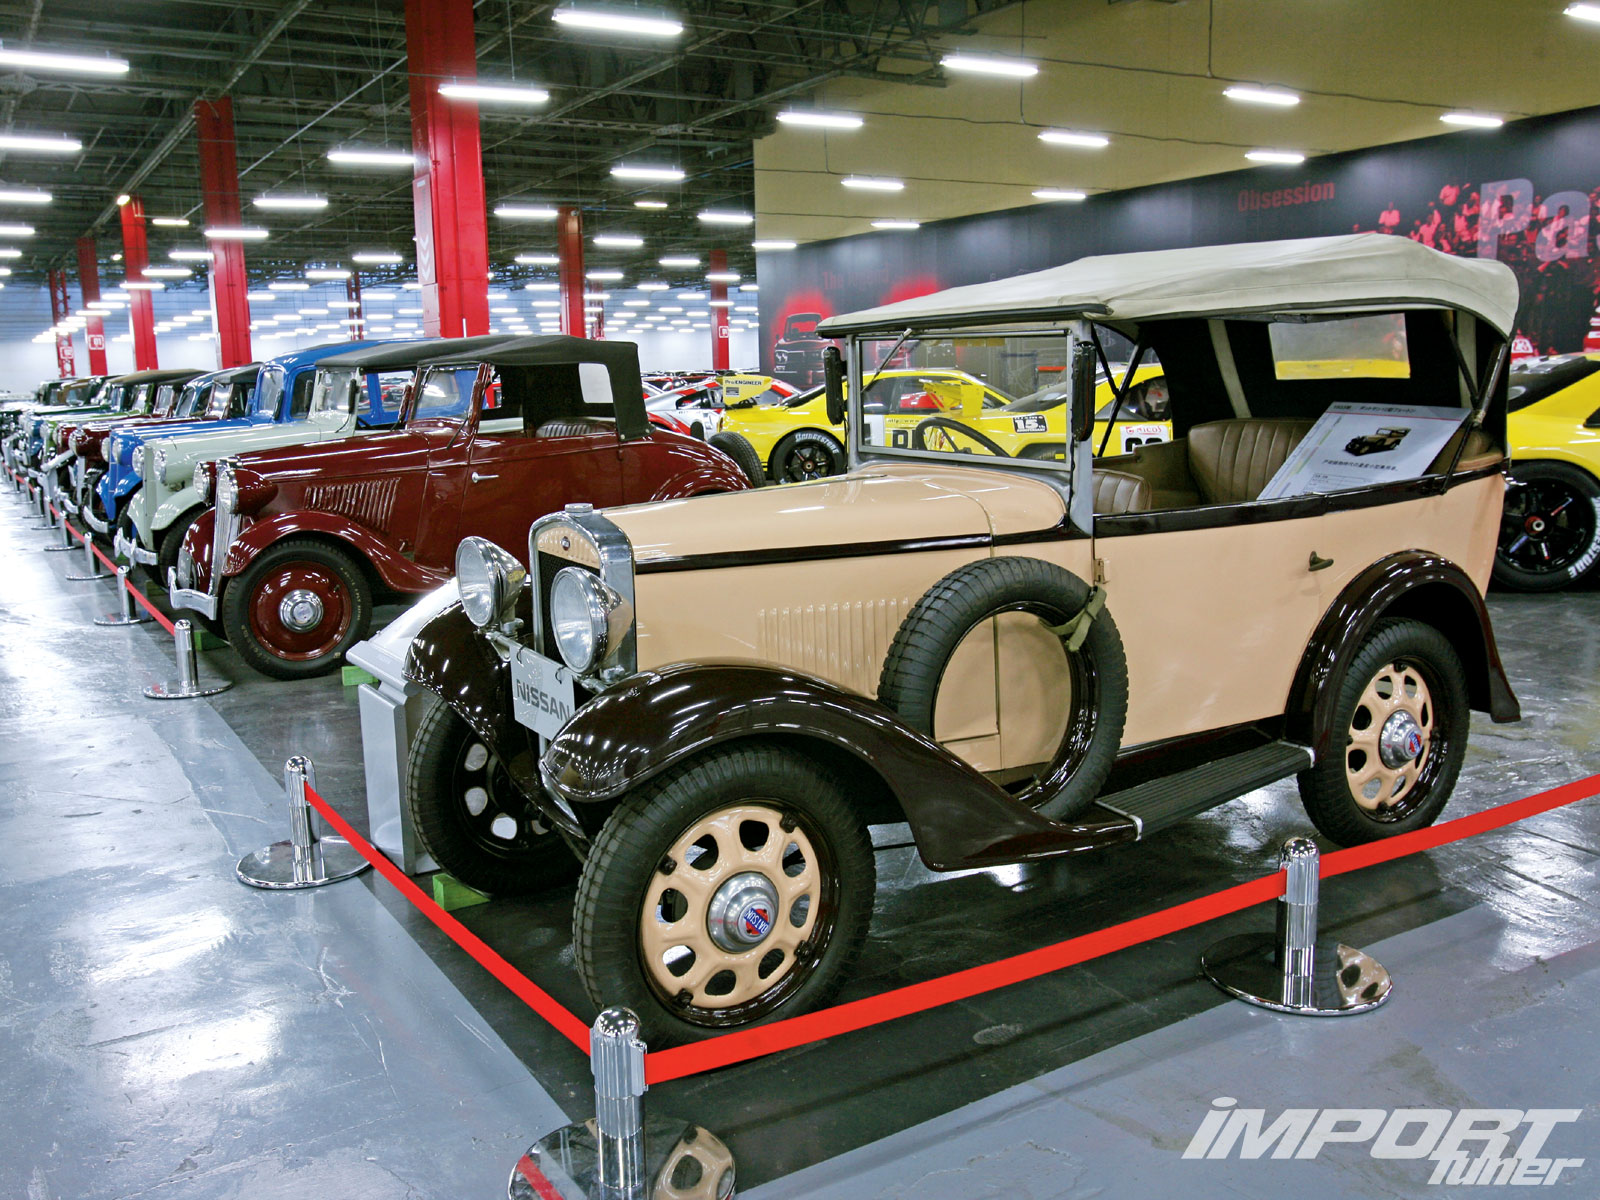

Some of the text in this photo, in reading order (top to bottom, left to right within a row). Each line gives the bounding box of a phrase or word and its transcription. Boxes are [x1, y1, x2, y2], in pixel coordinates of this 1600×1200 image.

[1238, 181, 1335, 212] Obsession
[1477, 178, 1600, 262] Pa
[516, 678, 570, 722] NISSAN
[744, 908, 769, 934] DATSUN
